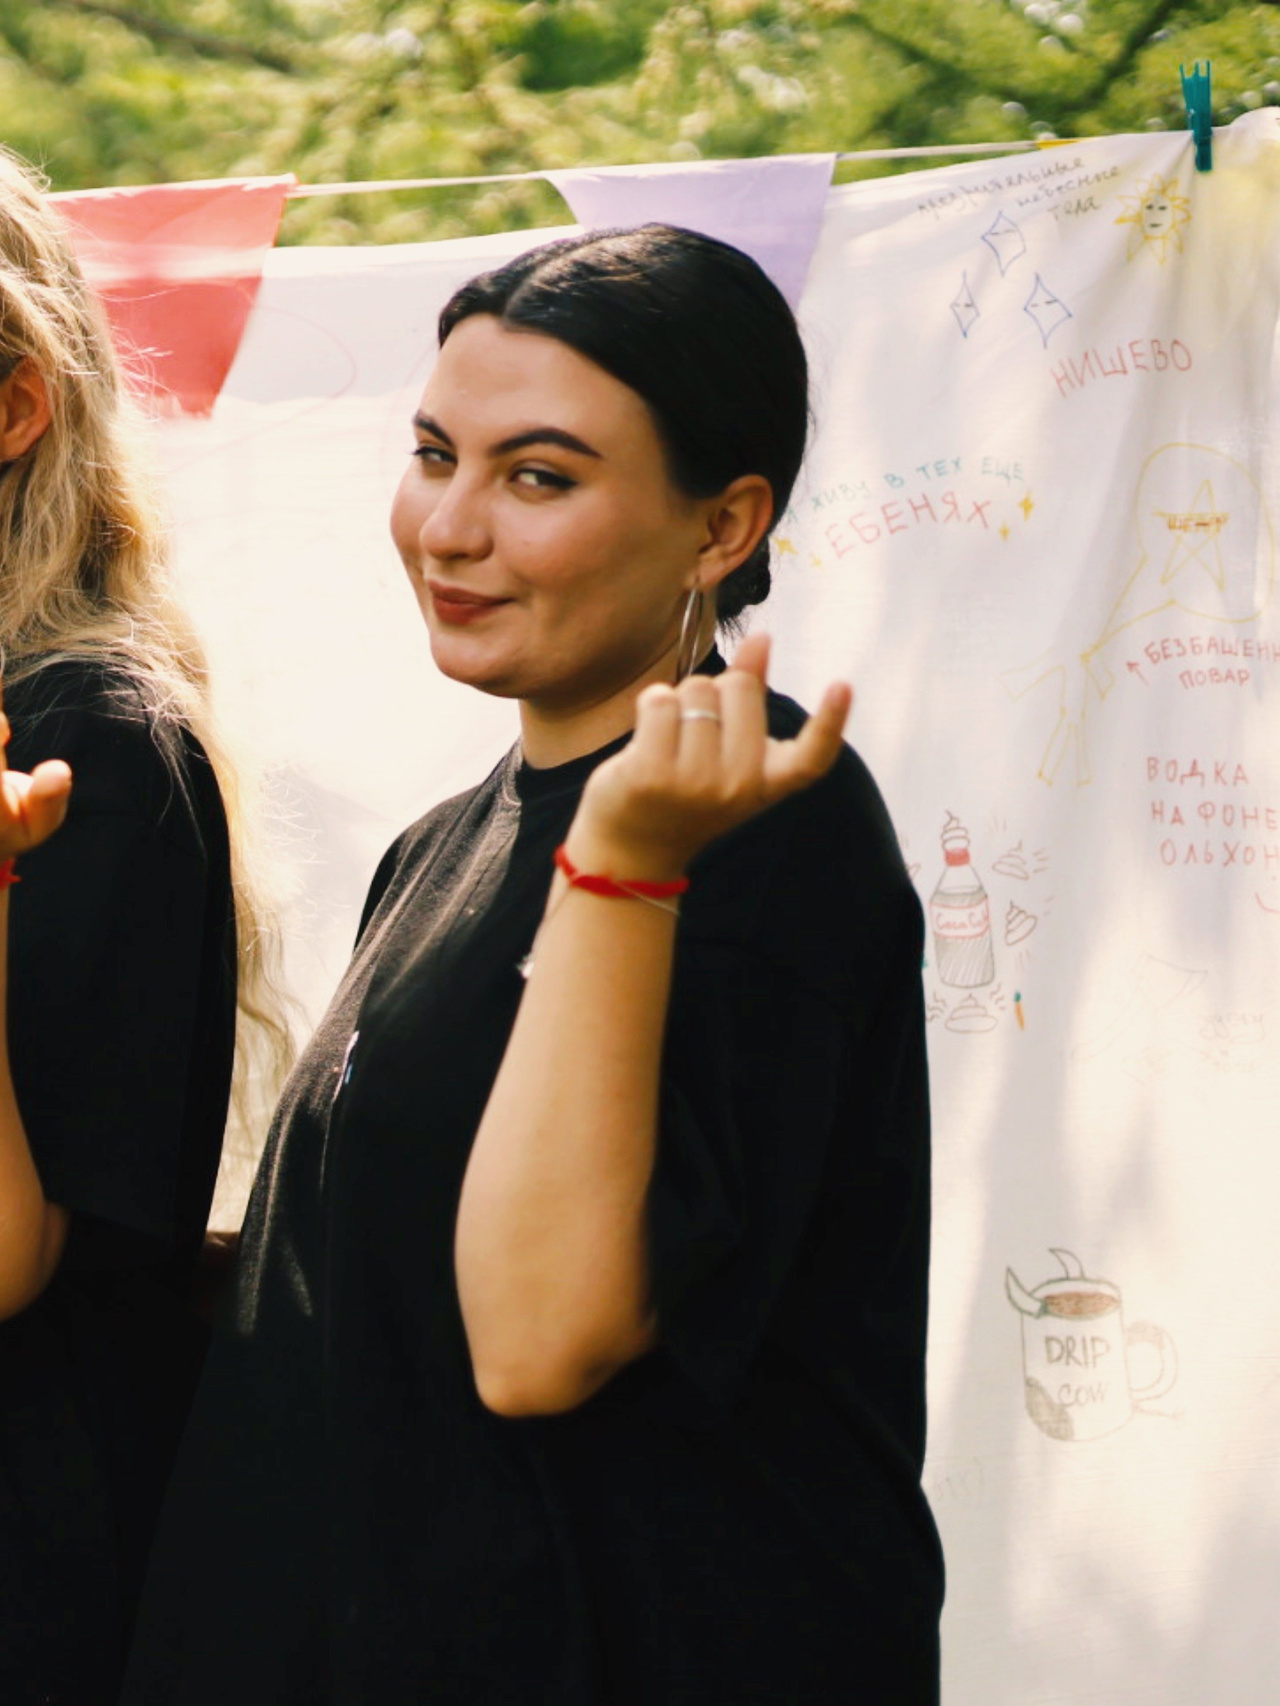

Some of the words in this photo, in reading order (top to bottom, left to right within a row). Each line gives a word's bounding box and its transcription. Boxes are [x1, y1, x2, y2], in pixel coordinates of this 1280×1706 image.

[1178, 667, 1251, 690] ПОВАР
[1146, 756, 1249, 788] ВОДКА
[1150, 799, 1186, 827] НА
[1196, 800, 1279, 830] ФОНЕ
[1160, 838, 1279, 870] ОЛЬХОН
[1044, 1334, 1111, 1369] DRIP
